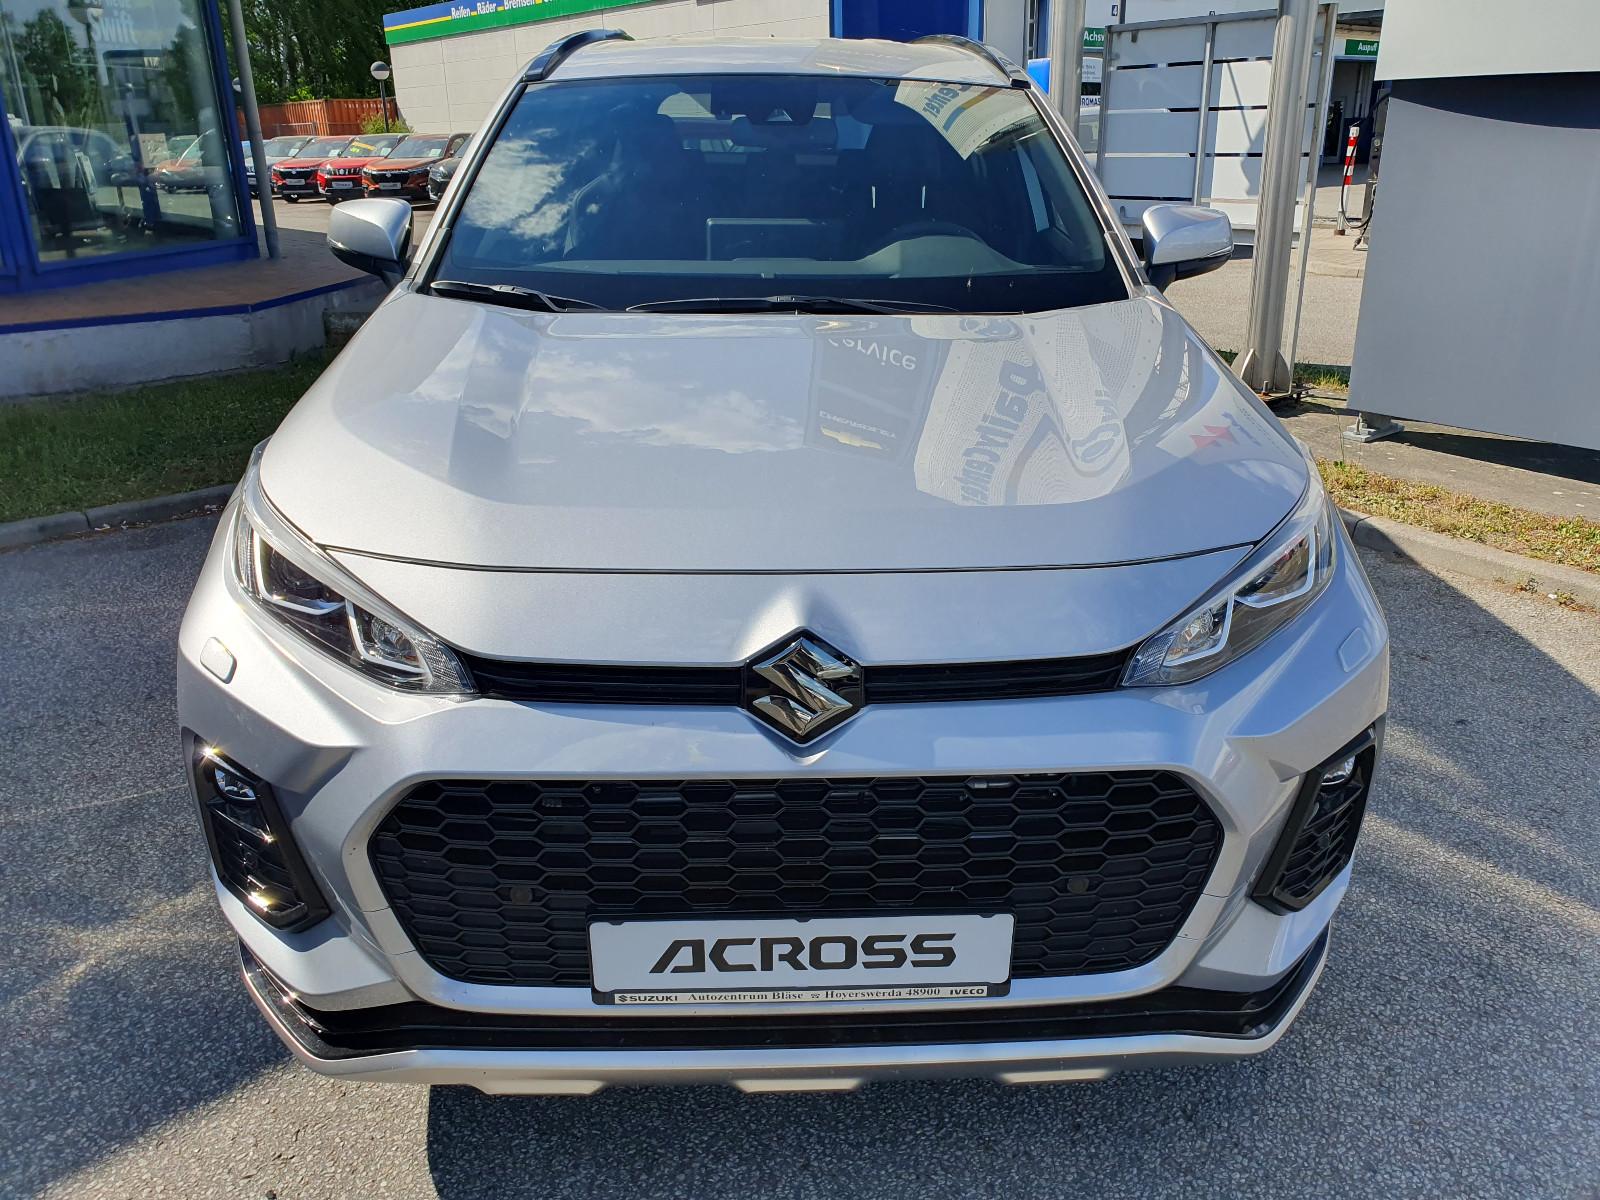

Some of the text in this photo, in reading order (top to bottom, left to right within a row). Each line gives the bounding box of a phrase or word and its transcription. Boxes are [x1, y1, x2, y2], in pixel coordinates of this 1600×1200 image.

[451, 5, 471, 20] Reifen
[477, 1, 496, 15] Räder
[649, 933, 957, 974] ACROSS
[688, 993, 768, 1001] Autozentrum
[772, 991, 803, 999] Bläse
[825, 989, 901, 999] Hoyerswerda
[906, 988, 940, 996] 48900
